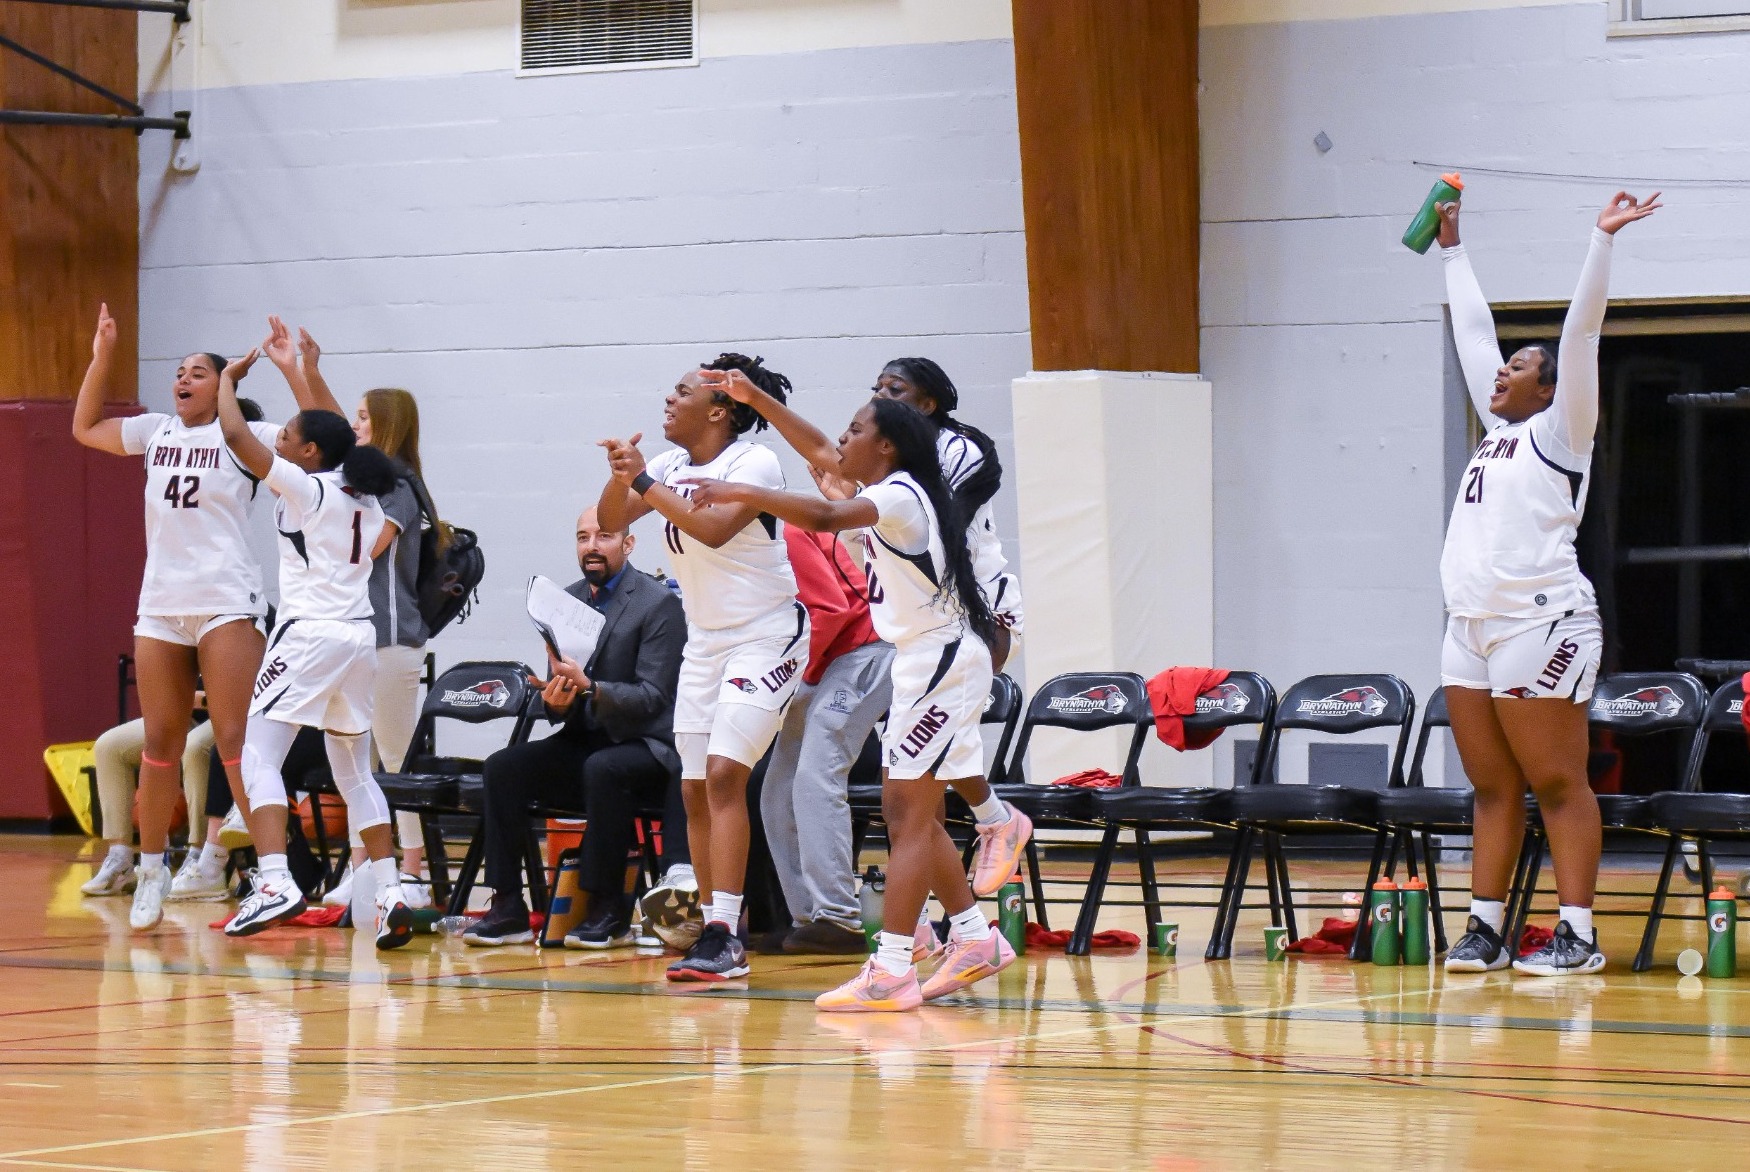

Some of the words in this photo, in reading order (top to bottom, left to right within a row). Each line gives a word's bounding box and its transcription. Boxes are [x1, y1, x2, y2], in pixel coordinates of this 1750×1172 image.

[153, 446, 182, 467] BRYN
[163, 475, 200, 509] 42
[1465, 465, 1486, 504] 21
[350, 510, 362, 564] 1
[253, 655, 288, 700] LIONS
[760, 657, 798, 694] LIONS
[1536, 637, 1579, 691] LIONS
[445, 693, 468, 701] BRYN
[468, 693, 493, 702] ATHYN
[1052, 699, 1077, 708] BRYN
[1077, 699, 1107, 708] ATHYN
[1302, 701, 1329, 711] BRYN
[1329, 701, 1363, 711] ATHYN
[1595, 700, 1624, 710] BRYN
[1624, 701, 1658, 710] ATHYN
[899, 704, 950, 759] LIONS
[1375, 903, 1392, 923] G
[1710, 912, 1727, 933] G
